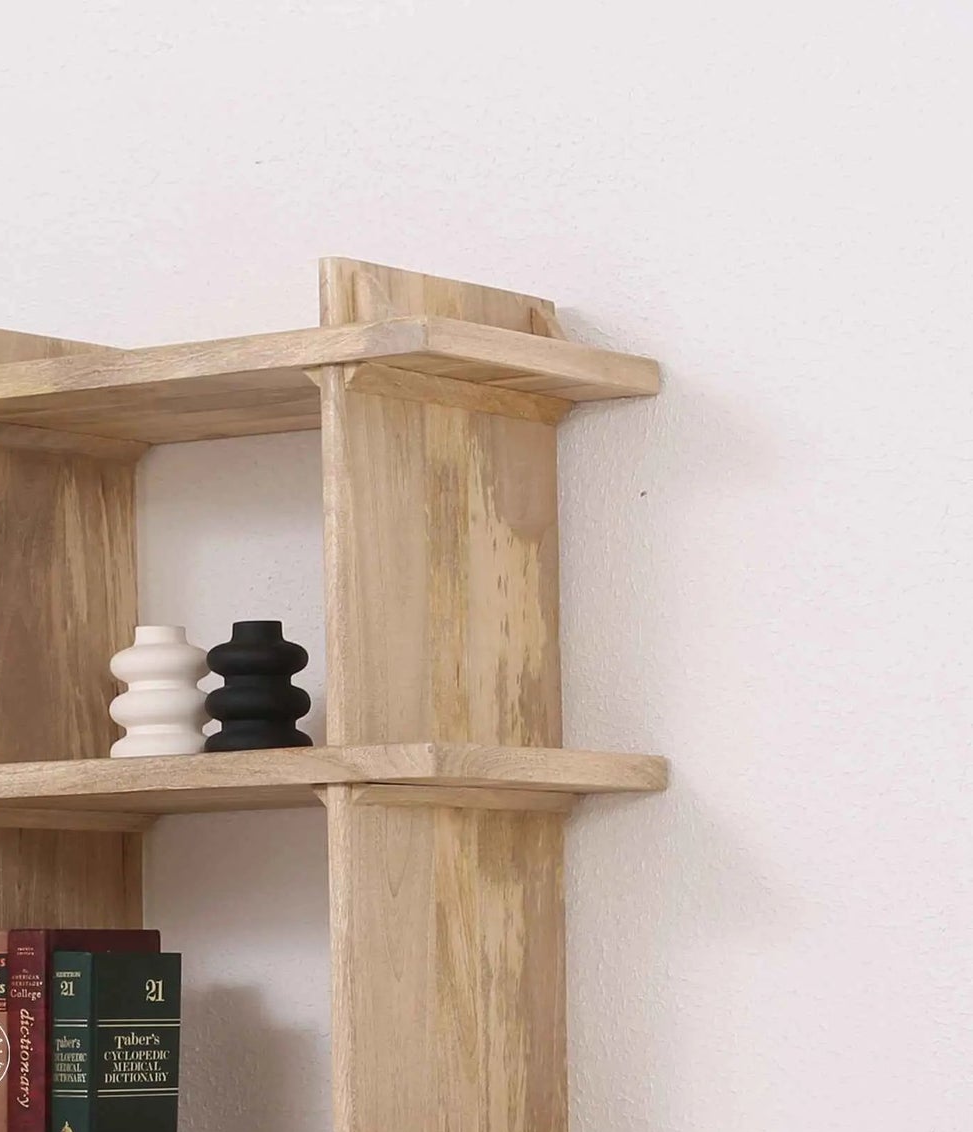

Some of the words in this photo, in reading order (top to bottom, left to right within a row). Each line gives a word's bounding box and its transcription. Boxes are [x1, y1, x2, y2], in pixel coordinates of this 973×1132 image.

[10, 988, 42, 1001] College
[60, 980, 75, 996] 21
[145, 979, 165, 1002] 21
[114, 1032, 160, 1049] Taber's
[103, 1050, 170, 1061] CYCLOPEDIC
[113, 1061, 162, 1072] MEDICAL
[104, 1072, 169, 1083] DICTIONARY
